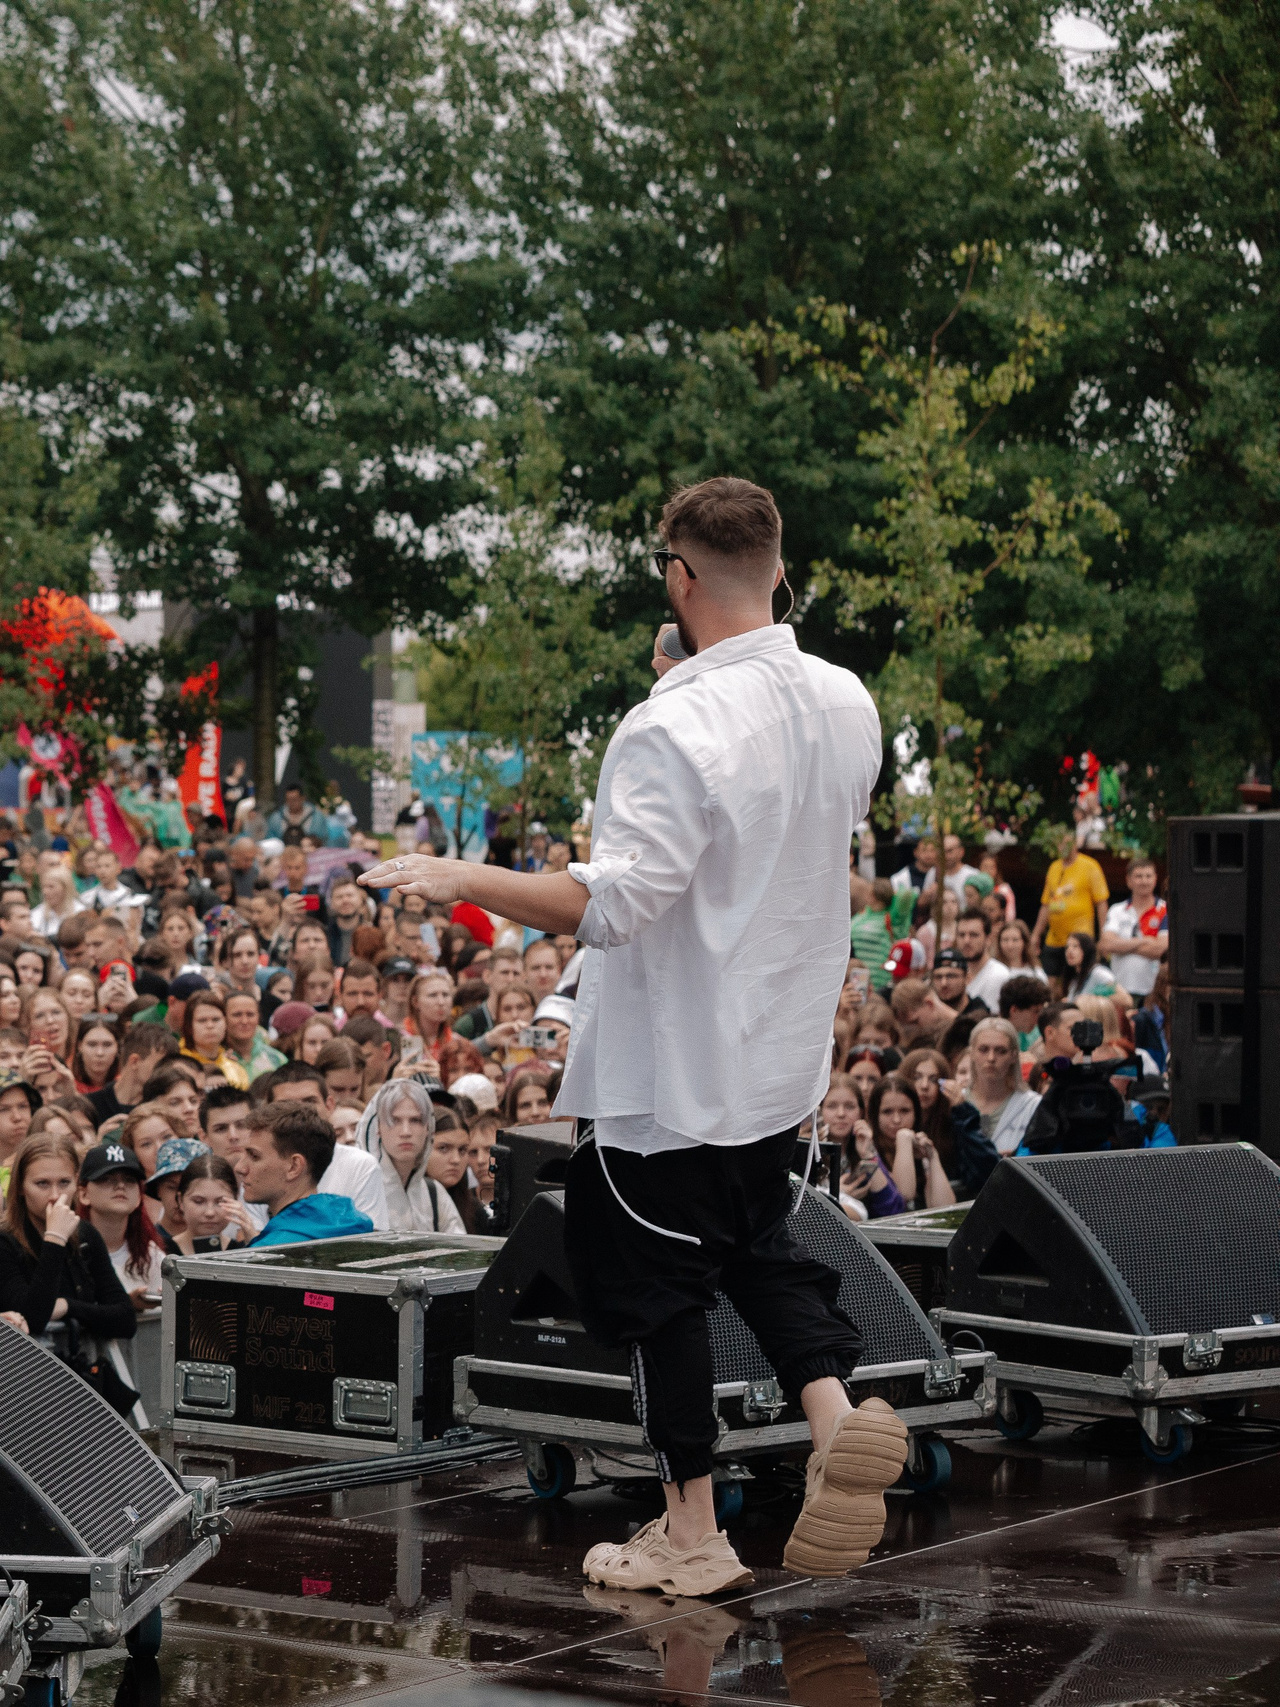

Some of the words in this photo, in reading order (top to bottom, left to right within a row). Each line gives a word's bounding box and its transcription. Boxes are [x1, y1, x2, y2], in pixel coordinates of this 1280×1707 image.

[106, 1145, 125, 1163] NY
[246, 1304, 337, 1346] Meyer
[537, 1334, 567, 1344] MJF-212A
[245, 1337, 336, 1373] Sound
[252, 1394, 291, 1420] MJF
[294, 1401, 327, 1424] 212
